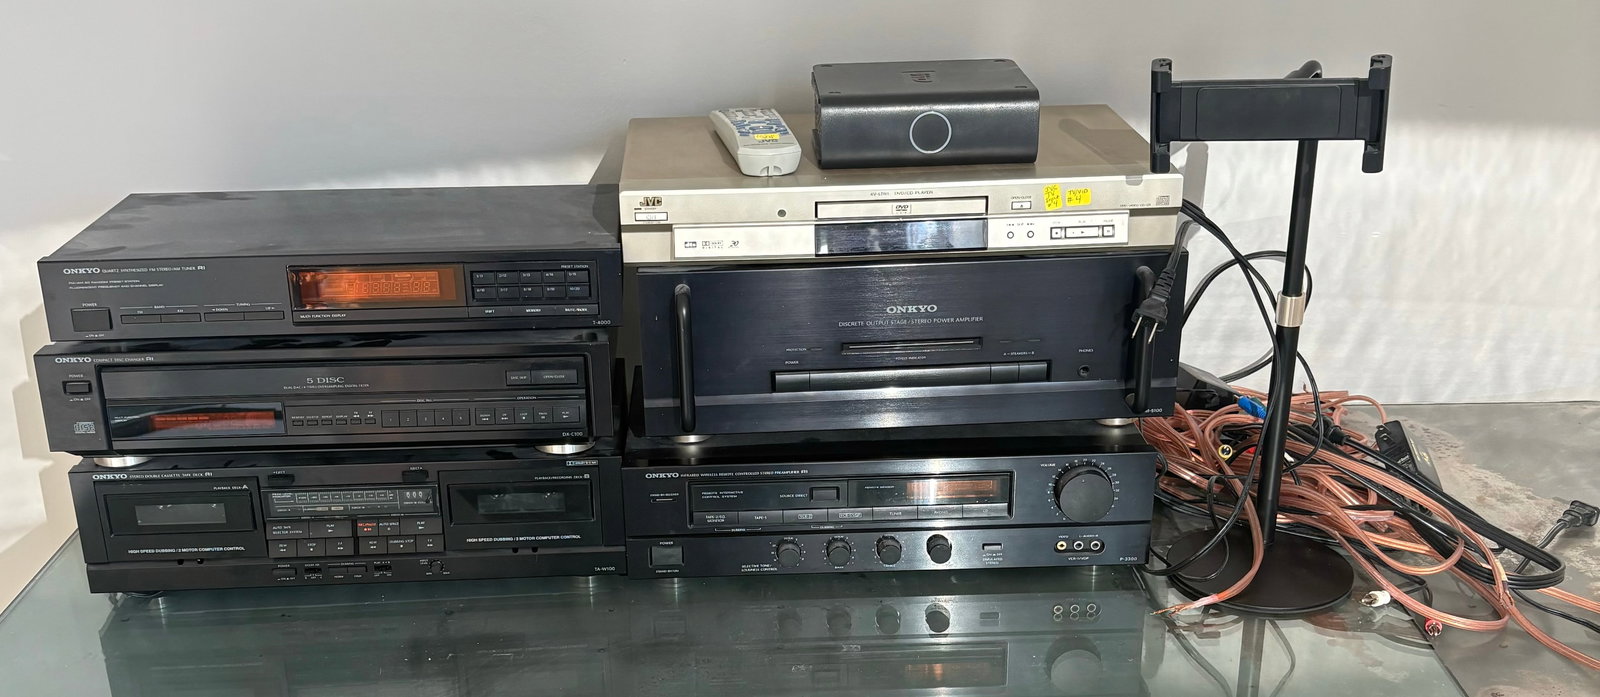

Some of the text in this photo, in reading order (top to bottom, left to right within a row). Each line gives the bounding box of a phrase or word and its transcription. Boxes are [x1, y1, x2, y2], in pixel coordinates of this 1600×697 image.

[640, 196, 663, 206] JVC
[63, 267, 101, 275] ONKYO
[886, 304, 938, 314] ONKYO
[55, 356, 92, 364] ONKYO
[306, 376, 345, 385] 5 DISC
[92, 473, 128, 481] ONKYO
[645, 472, 680, 480] ONKYO
